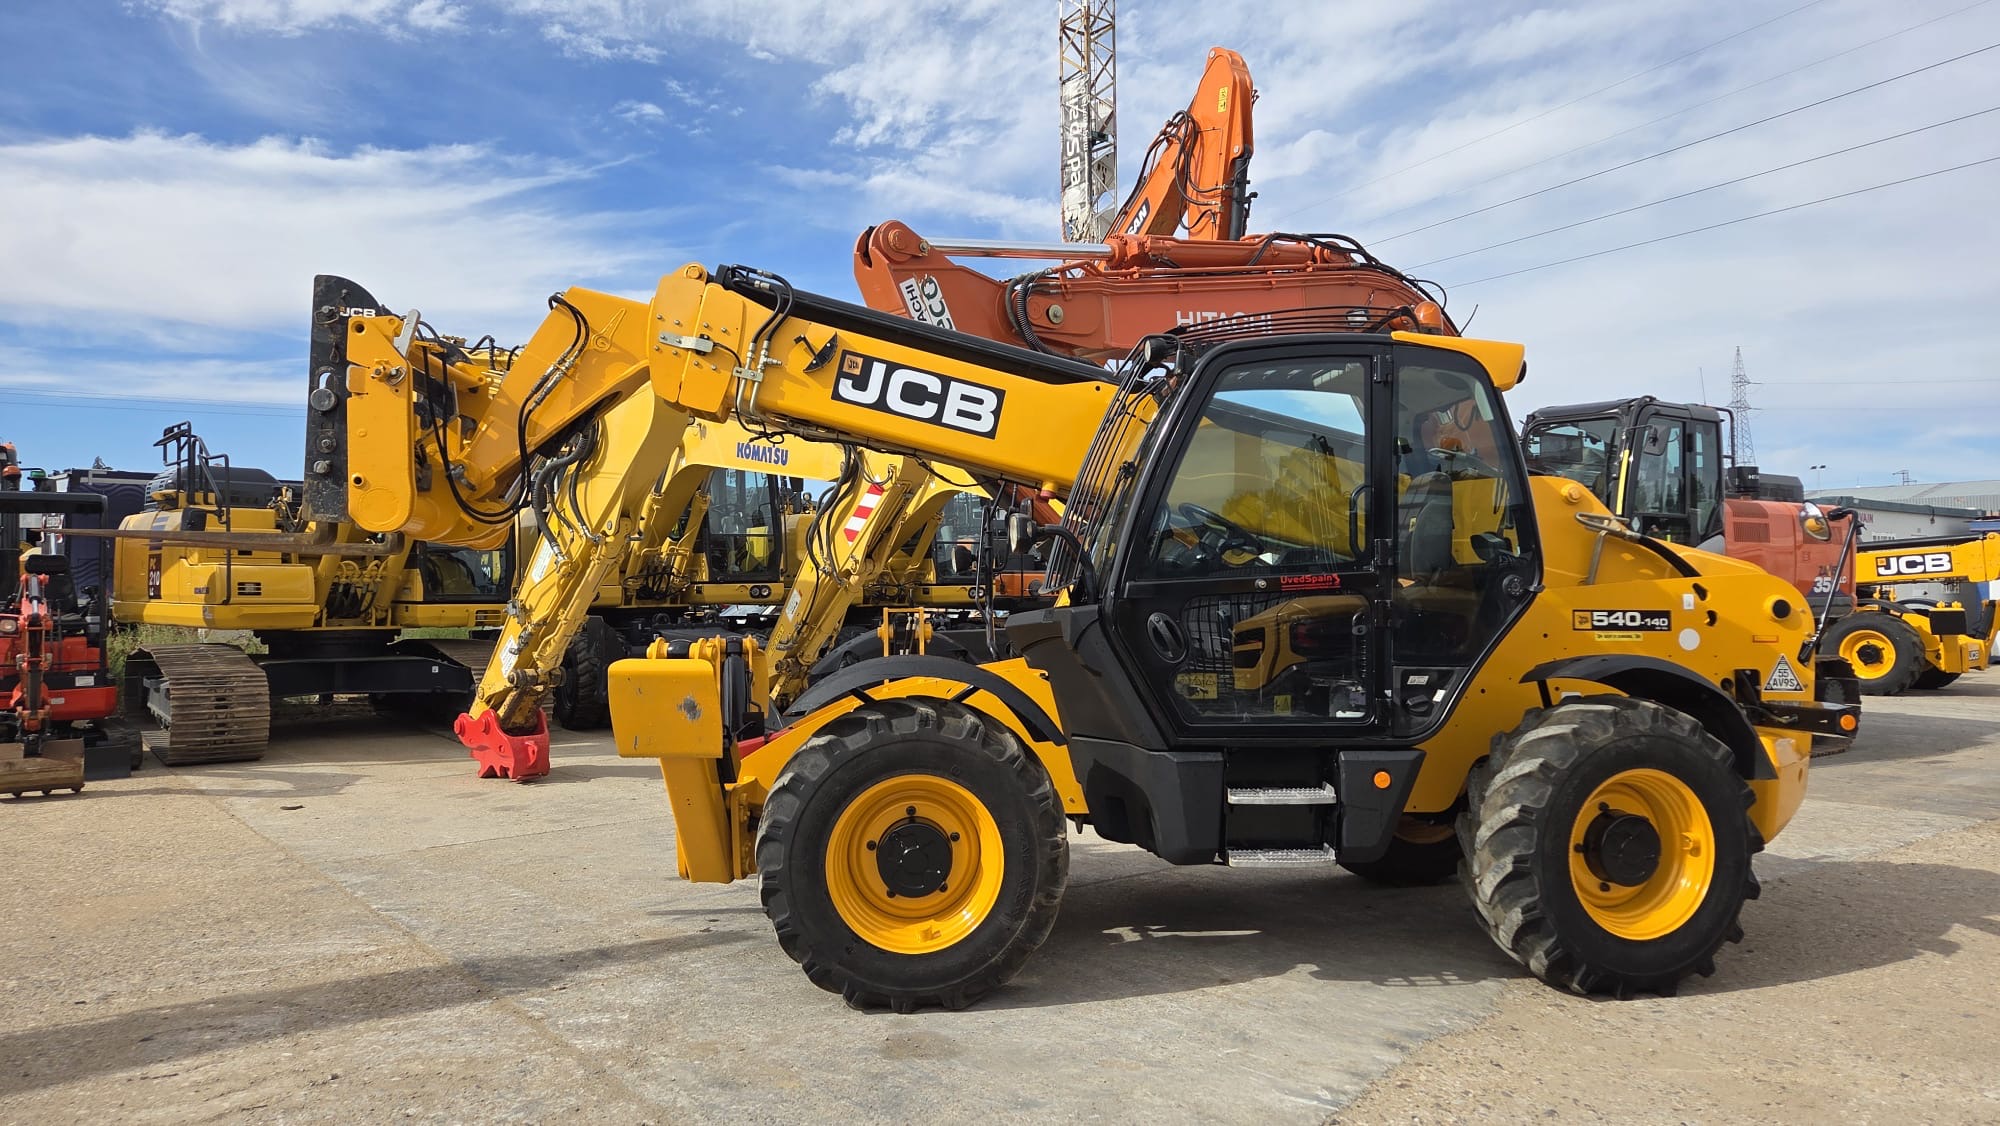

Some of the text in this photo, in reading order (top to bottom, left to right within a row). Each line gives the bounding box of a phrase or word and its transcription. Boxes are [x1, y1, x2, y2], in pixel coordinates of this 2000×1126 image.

[340, 307, 376, 318] JCB
[838, 361, 998, 433] JCB
[736, 442, 789, 466] KOMATSU
[1877, 553, 1952, 576] JCB
[149, 571, 160, 586] 210
[1280, 574, 1333, 584] UvedSpain
[1813, 576, 1840, 593] 35
[1592, 611, 1669, 627] 540-140
